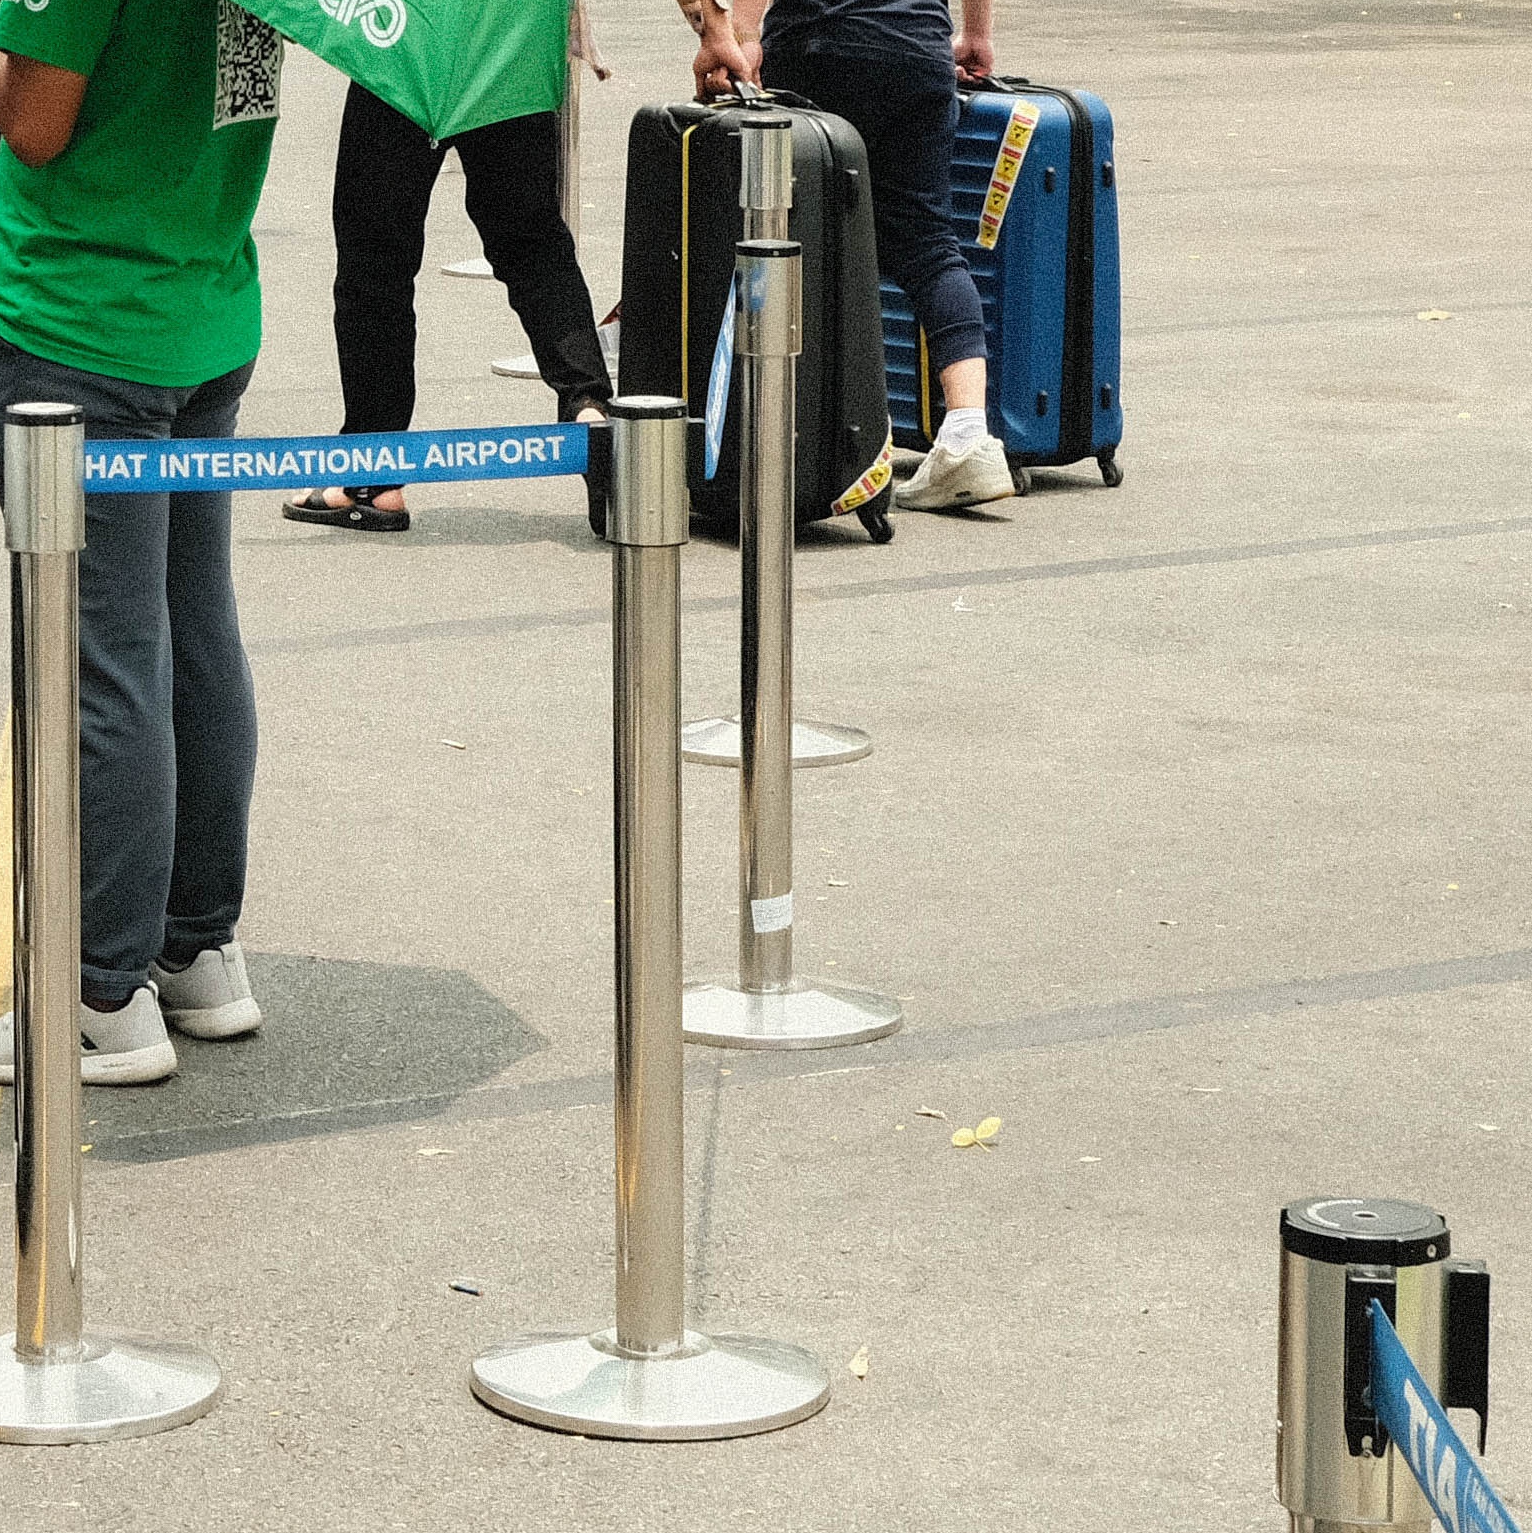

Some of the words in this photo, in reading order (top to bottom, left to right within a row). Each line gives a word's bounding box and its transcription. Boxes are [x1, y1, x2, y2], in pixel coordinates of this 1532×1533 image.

[85, 453, 148, 479] HAT
[159, 445, 417, 479] INTERNATIONAL
[424, 435, 566, 469] AIRPORT
